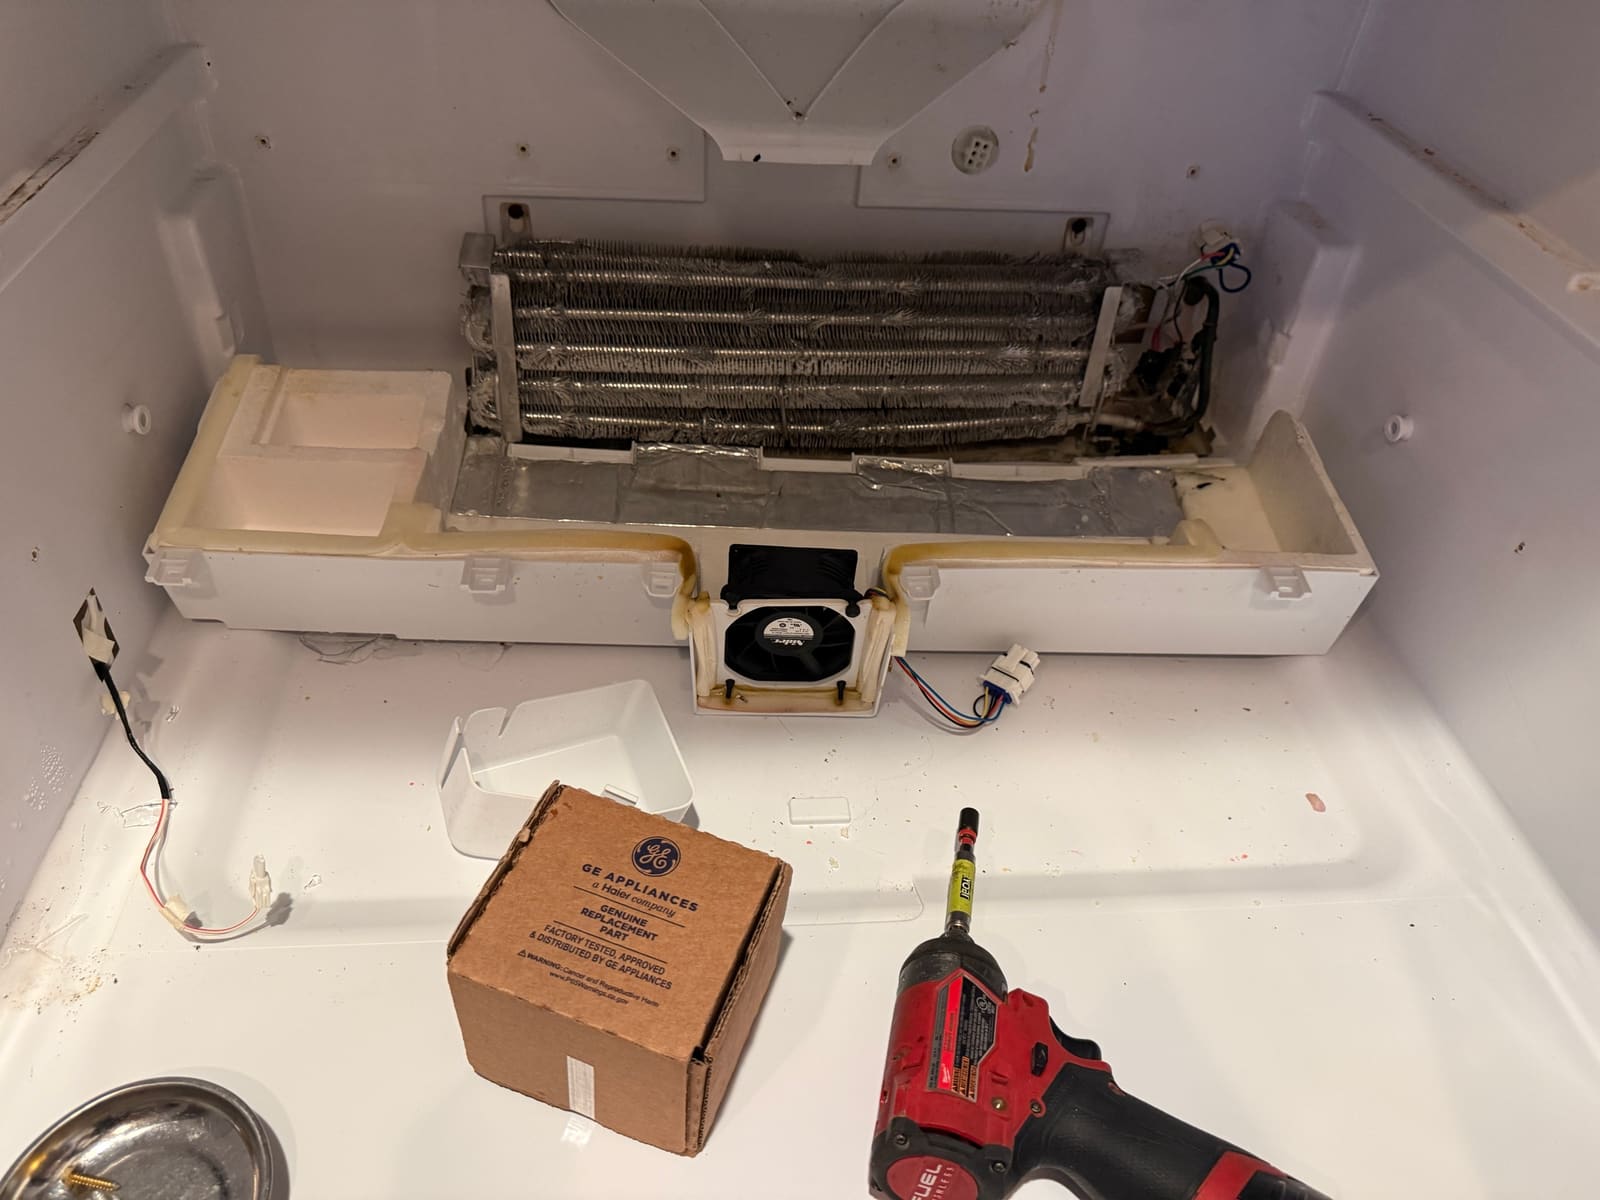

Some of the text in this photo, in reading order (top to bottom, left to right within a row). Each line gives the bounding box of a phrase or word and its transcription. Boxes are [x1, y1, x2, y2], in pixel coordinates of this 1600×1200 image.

[582, 863, 699, 912] GE APPLIANCES
[602, 883, 632, 900] Haier
[631, 894, 676, 918] company
[580, 907, 659, 941] REPLACEMENT
[600, 904, 648, 927] GENUINE
[544, 924, 665, 975] FACTORY TESTED, APPROVED
[599, 925, 629, 941] PART
[527, 952, 563, 971] WARNING:
[537, 933, 592, 960] DISTRIBUTED
[591, 953, 605, 965] BY
[605, 959, 618, 970] GE
[618, 964, 673, 990] APPLIANCES
